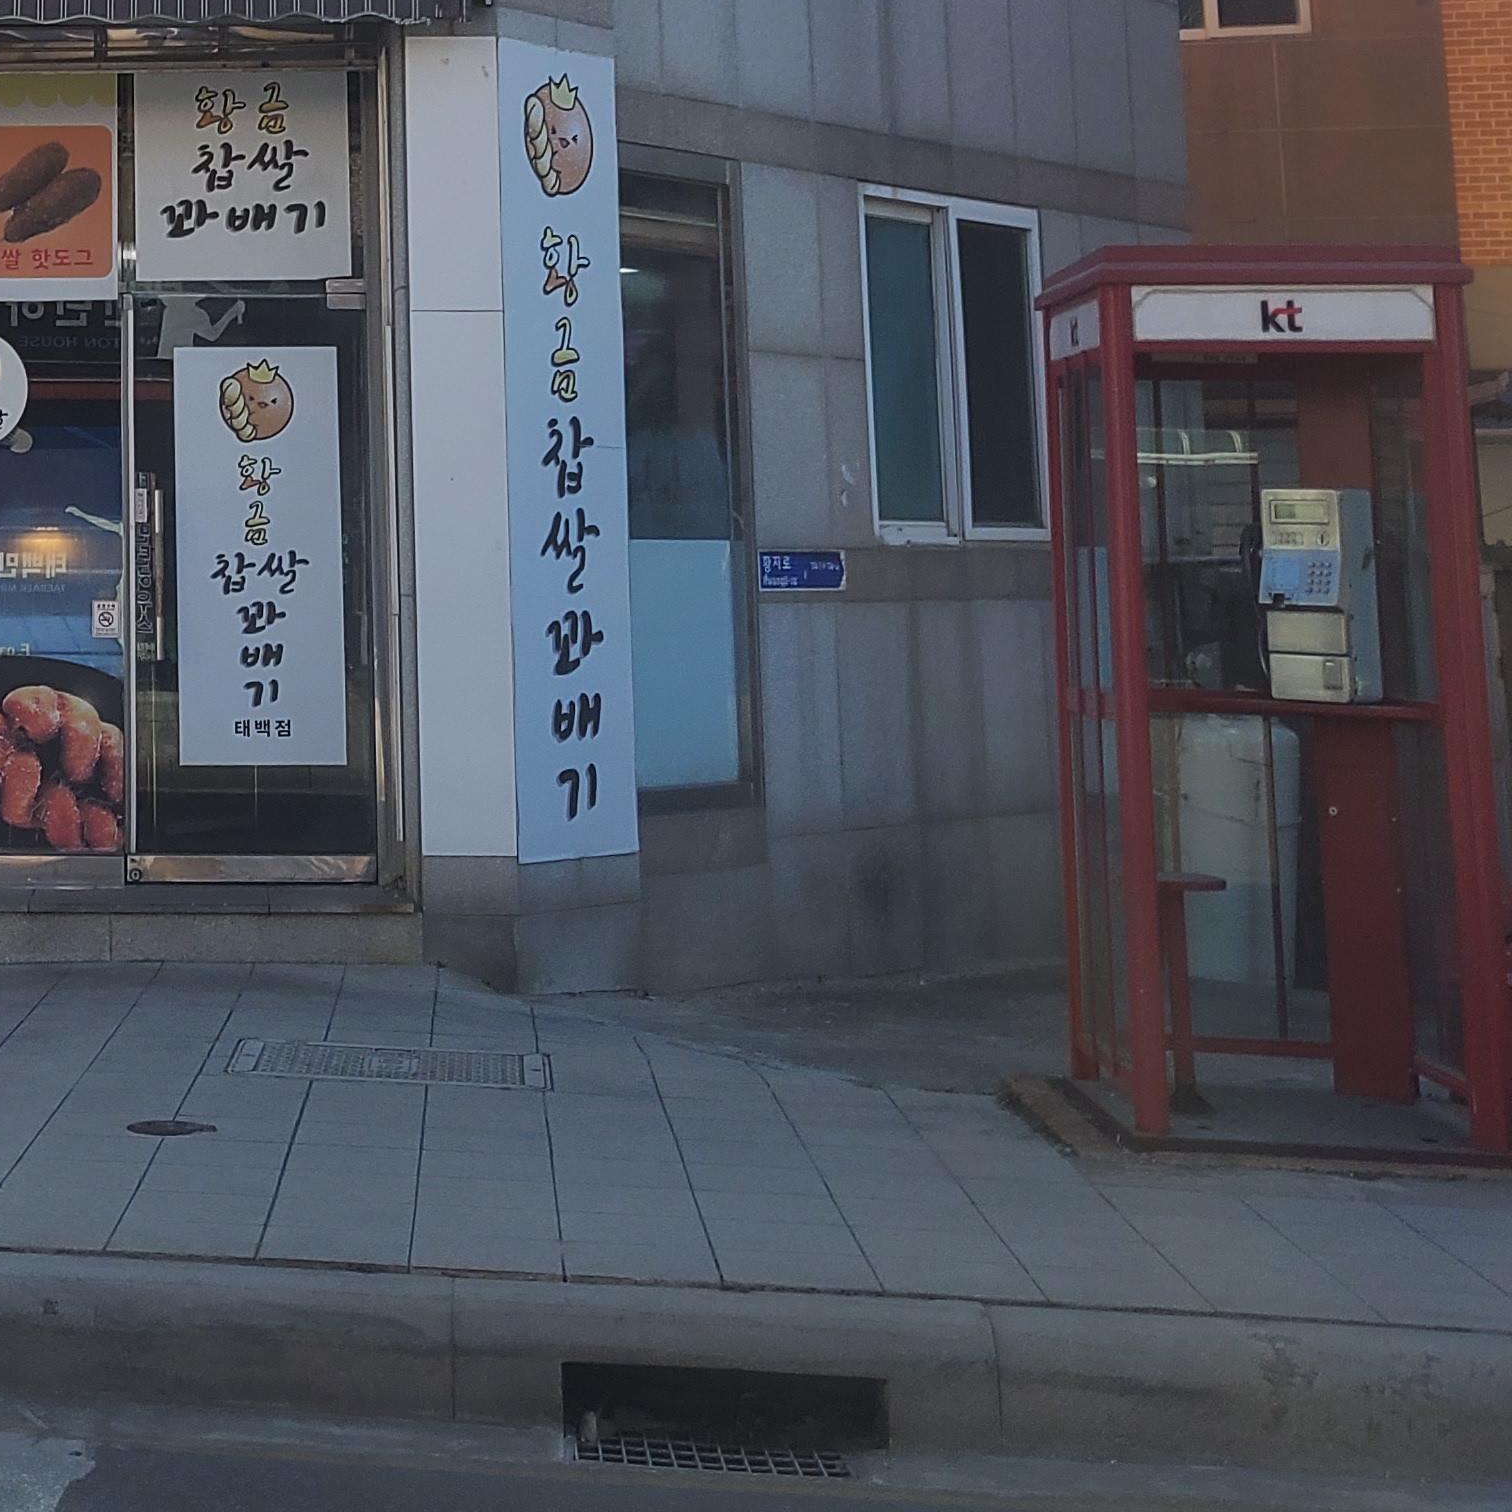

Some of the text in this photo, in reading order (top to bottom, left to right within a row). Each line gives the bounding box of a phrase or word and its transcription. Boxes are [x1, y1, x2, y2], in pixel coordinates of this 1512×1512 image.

[195, 82, 289, 134] 황금
[191, 140, 309, 191] 찹쌀
[160, 199, 326, 237] 꽈배기
[32, 249, 94, 269] 핫도그
[1260, 299, 1303, 333] kt
[237, 454, 282, 546] 황금
[210, 549, 309, 595] 찹쌀
[762, 555, 791, 572] 황지로
[236, 600, 286, 709] 꽈배기
[234, 719, 292, 739] 태백점
